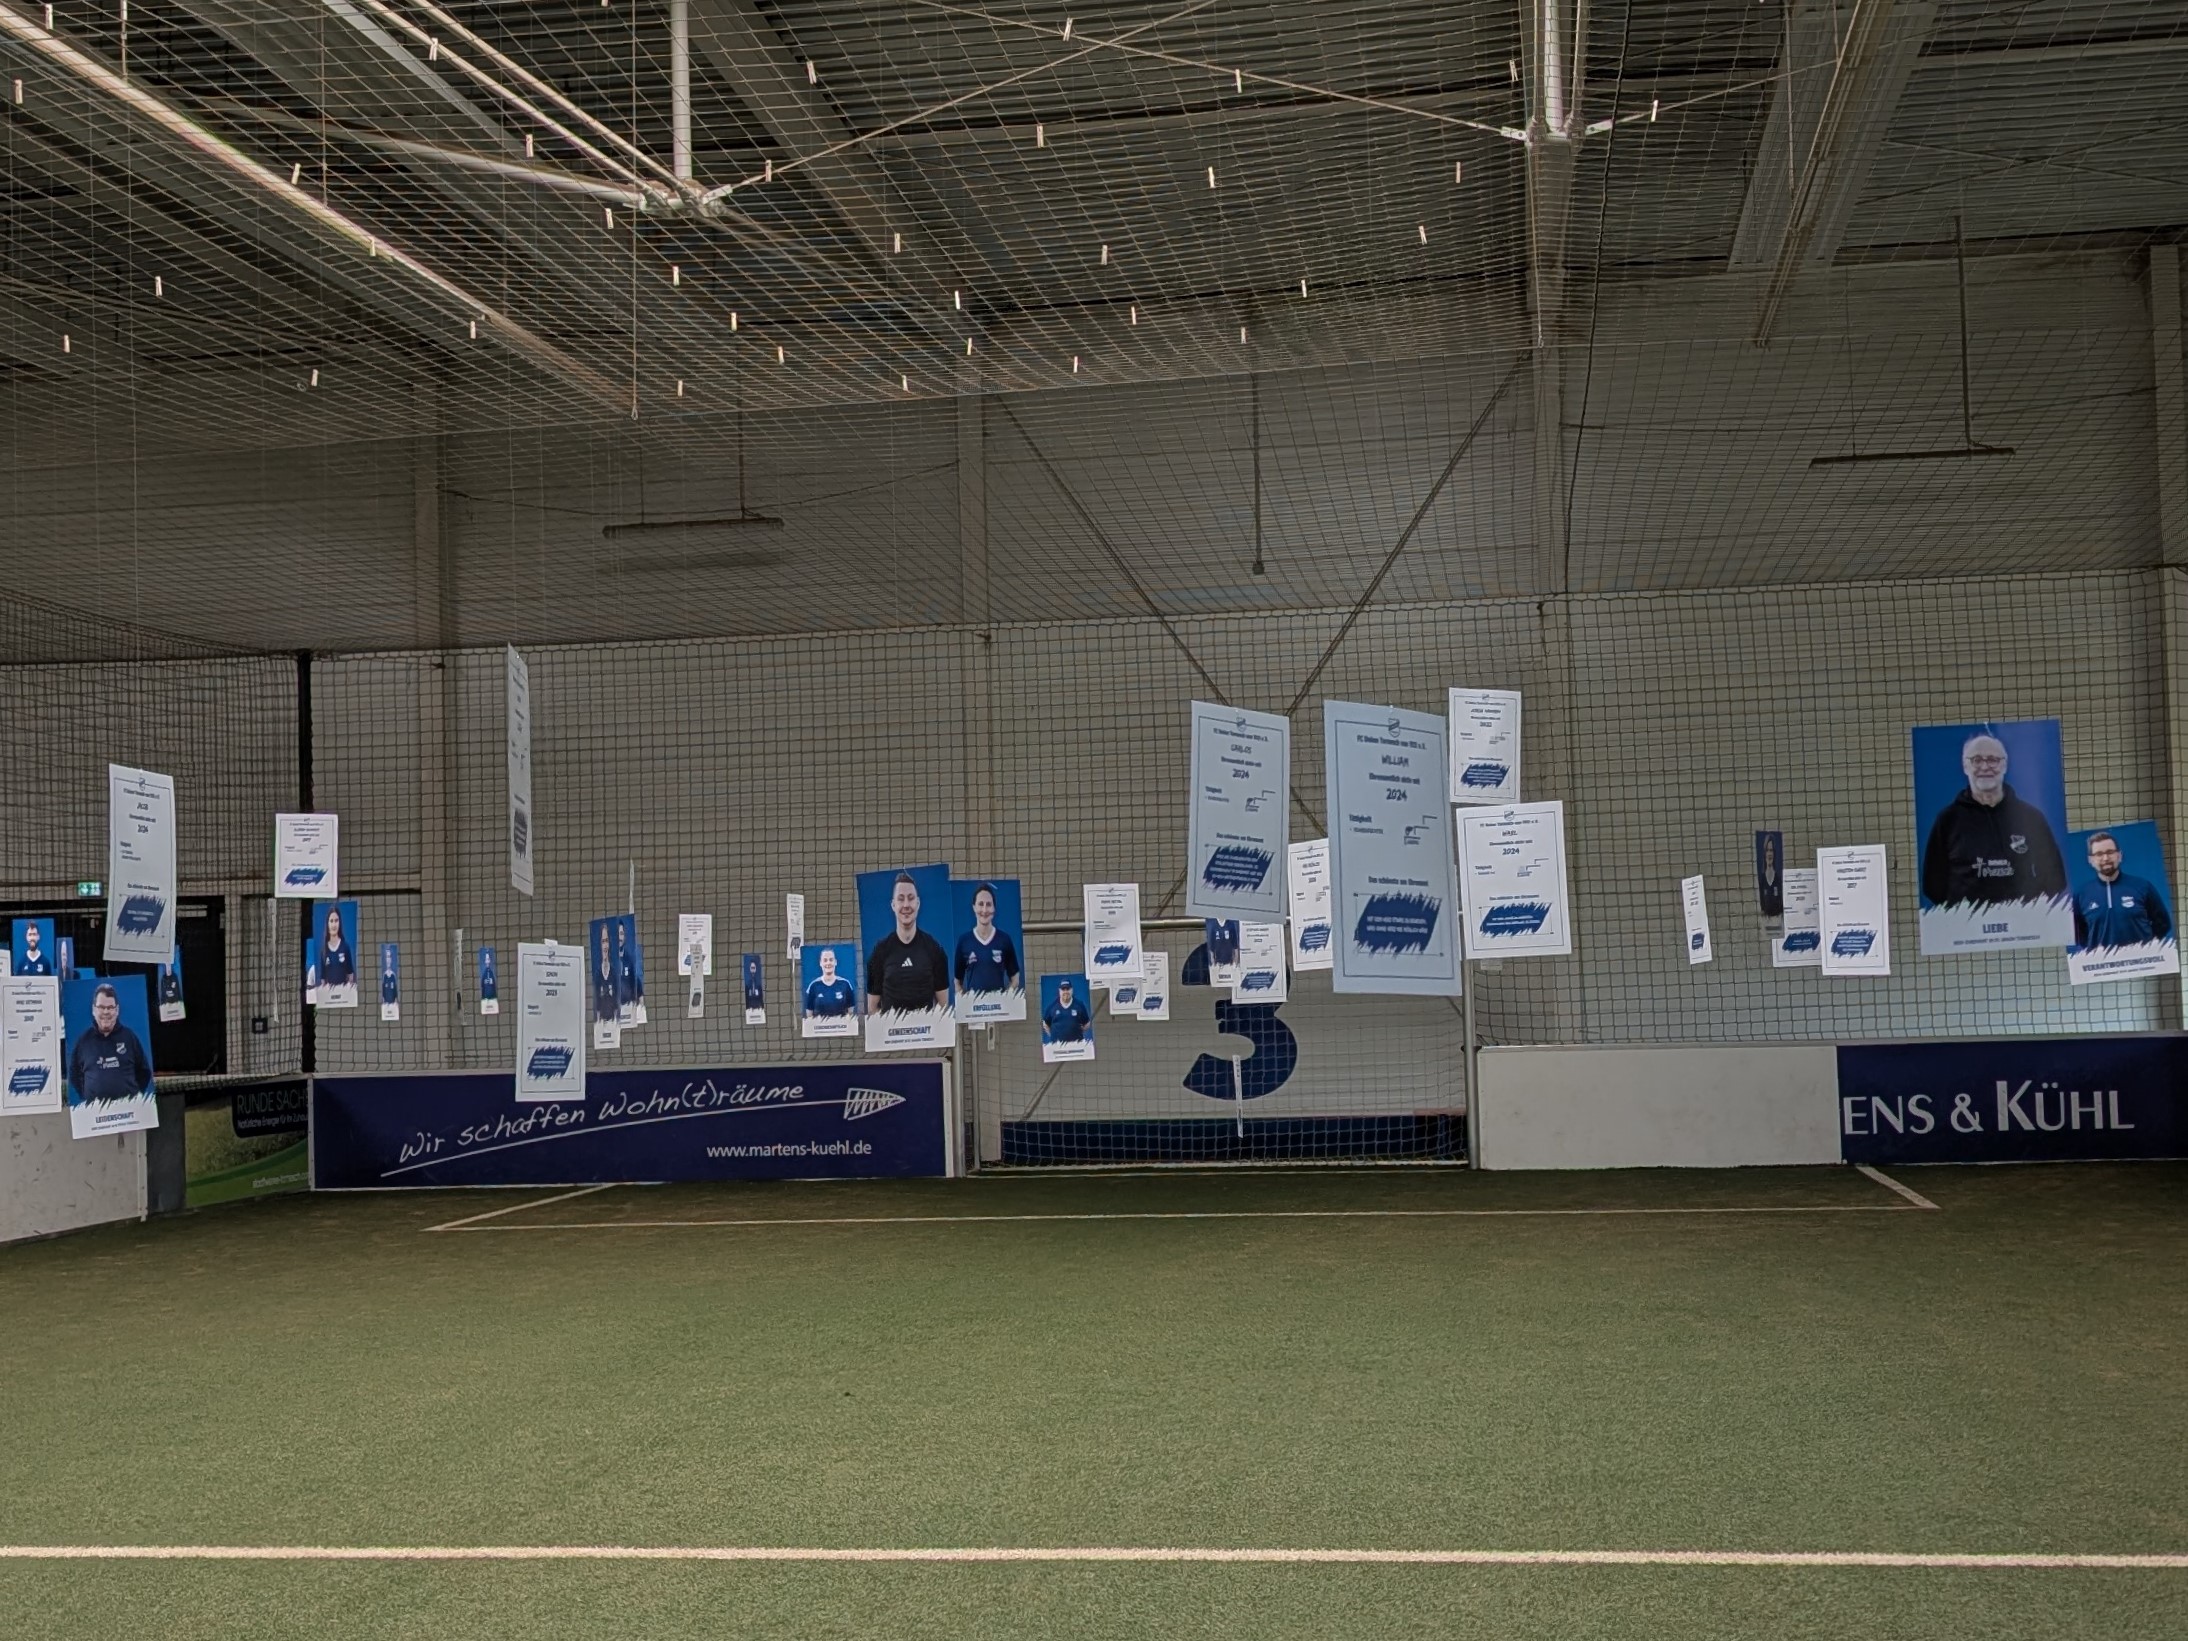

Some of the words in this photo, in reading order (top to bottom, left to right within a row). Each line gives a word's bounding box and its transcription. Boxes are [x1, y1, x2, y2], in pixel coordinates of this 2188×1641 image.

[1386, 788, 1408, 801] 2024
[1982, 922, 2009, 934] LIEBE
[2082, 955, 2166, 972] VERANTWORTUNGSVOLL
[1182, 940, 1297, 1100] 3
[888, 1026, 932, 1037] GEMEINSCHAFT
[238, 1091, 274, 1114] RUNDE
[1951, 1093, 1984, 1133] &
[1996, 1080, 2135, 1131] KÜHL
[400, 1132, 445, 1163] Wir
[460, 1105, 585, 1146] schaffen
[600, 1079, 804, 1121] Wohn(t)räume
[707, 1140, 872, 1158] www.martens-kuehl.de
